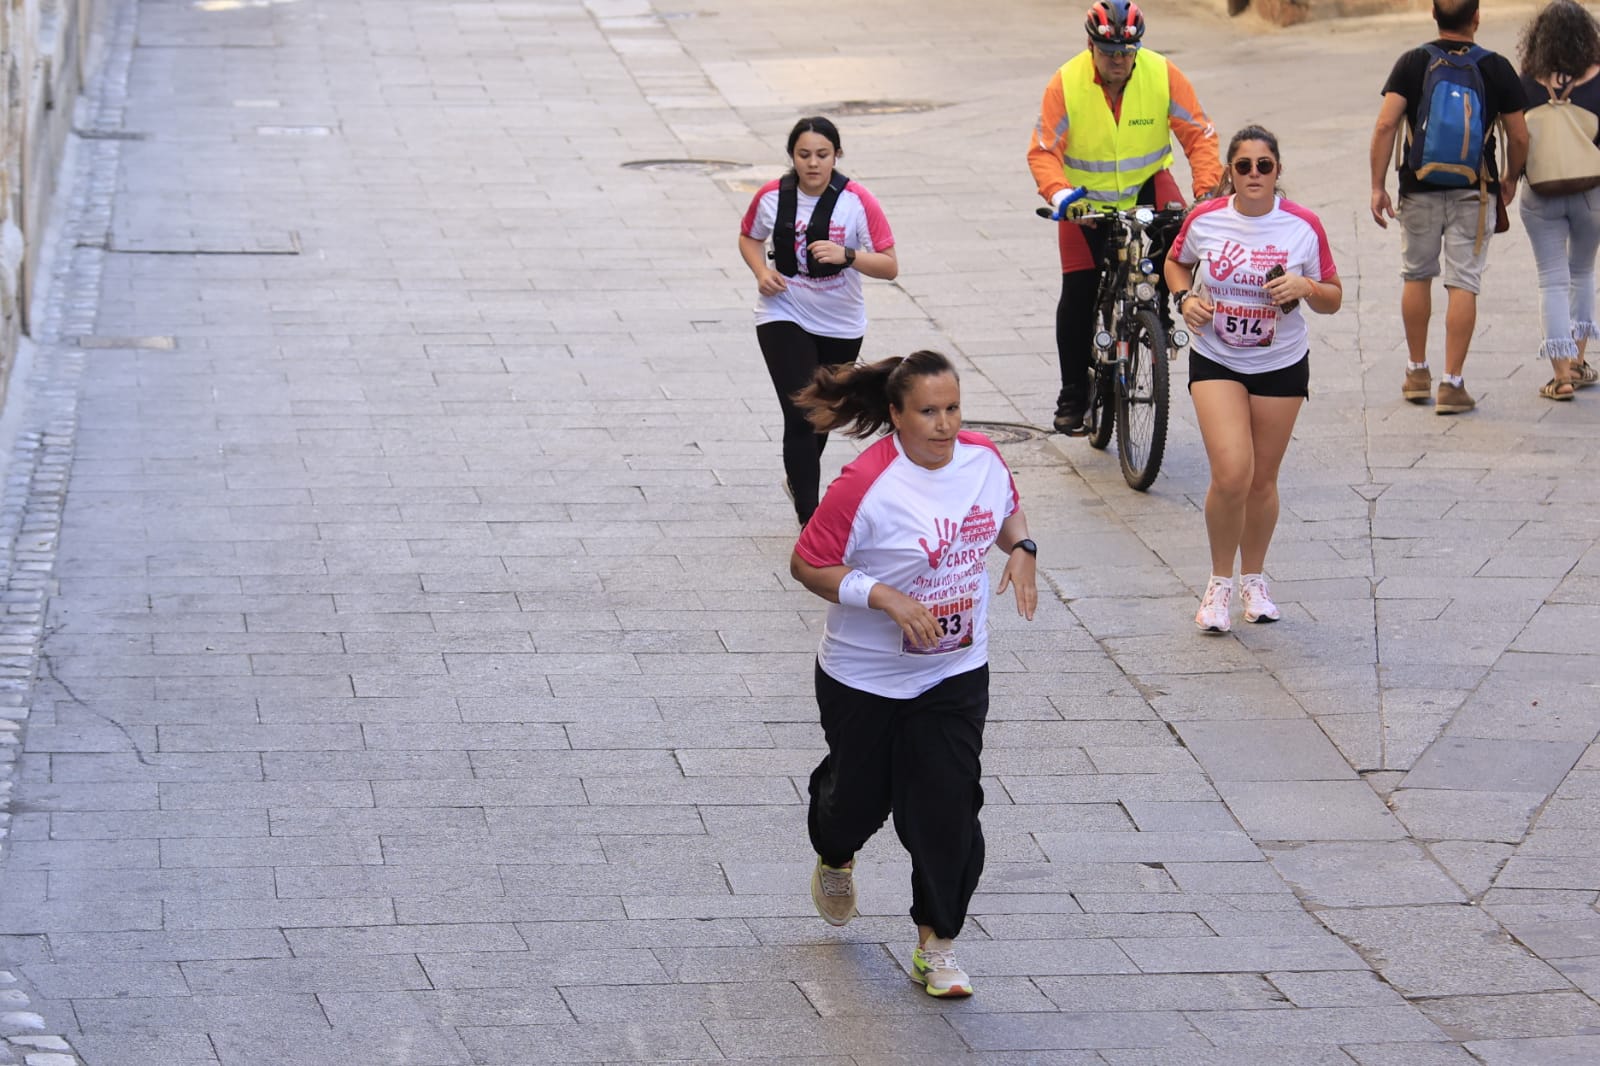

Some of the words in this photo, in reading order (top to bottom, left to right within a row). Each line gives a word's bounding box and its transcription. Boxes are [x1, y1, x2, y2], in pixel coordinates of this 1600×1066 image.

[1233, 273, 1264, 287] CARR
[1226, 316, 1262, 336] 514
[946, 547, 985, 568] CARRE
[929, 598, 973, 618] dunia
[937, 614, 962, 636] 33
